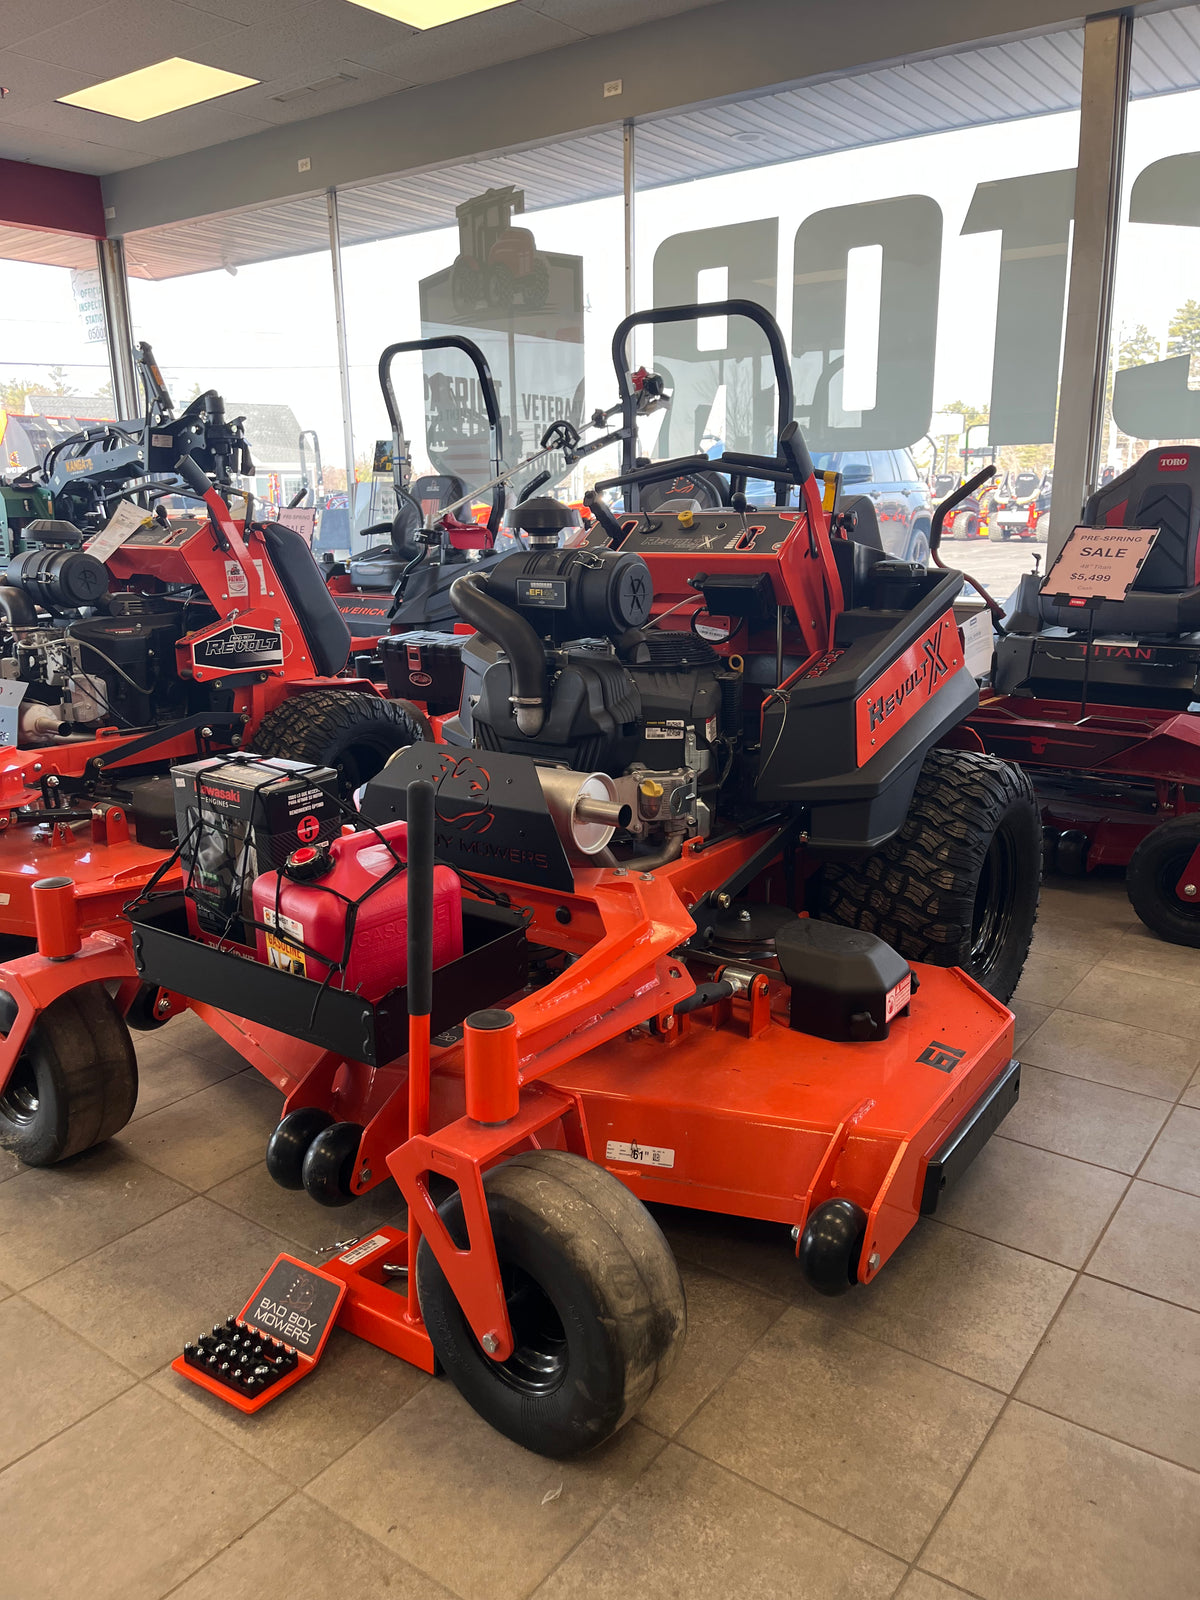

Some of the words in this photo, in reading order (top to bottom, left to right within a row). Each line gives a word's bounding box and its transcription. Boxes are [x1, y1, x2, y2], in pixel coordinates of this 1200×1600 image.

[85, 313, 103, 325] STATIO
[1160, 458, 1187, 467] TORO
[1080, 534, 1143, 543] PRE-SPRING
[1080, 547, 1128, 559] SALE
[1069, 572, 1112, 583] $5,499
[339, 606, 388, 617] VERICK
[1079, 645, 1152, 660] TITAN
[205, 797, 229, 808] ENGINES
[357, 903, 449, 947] GASOE
[267, 932, 302, 959] GASOLINE
[260, 1297, 288, 1318] BAD
[288, 1311, 318, 1332] BOY
[253, 1307, 312, 1345] MOWERS
